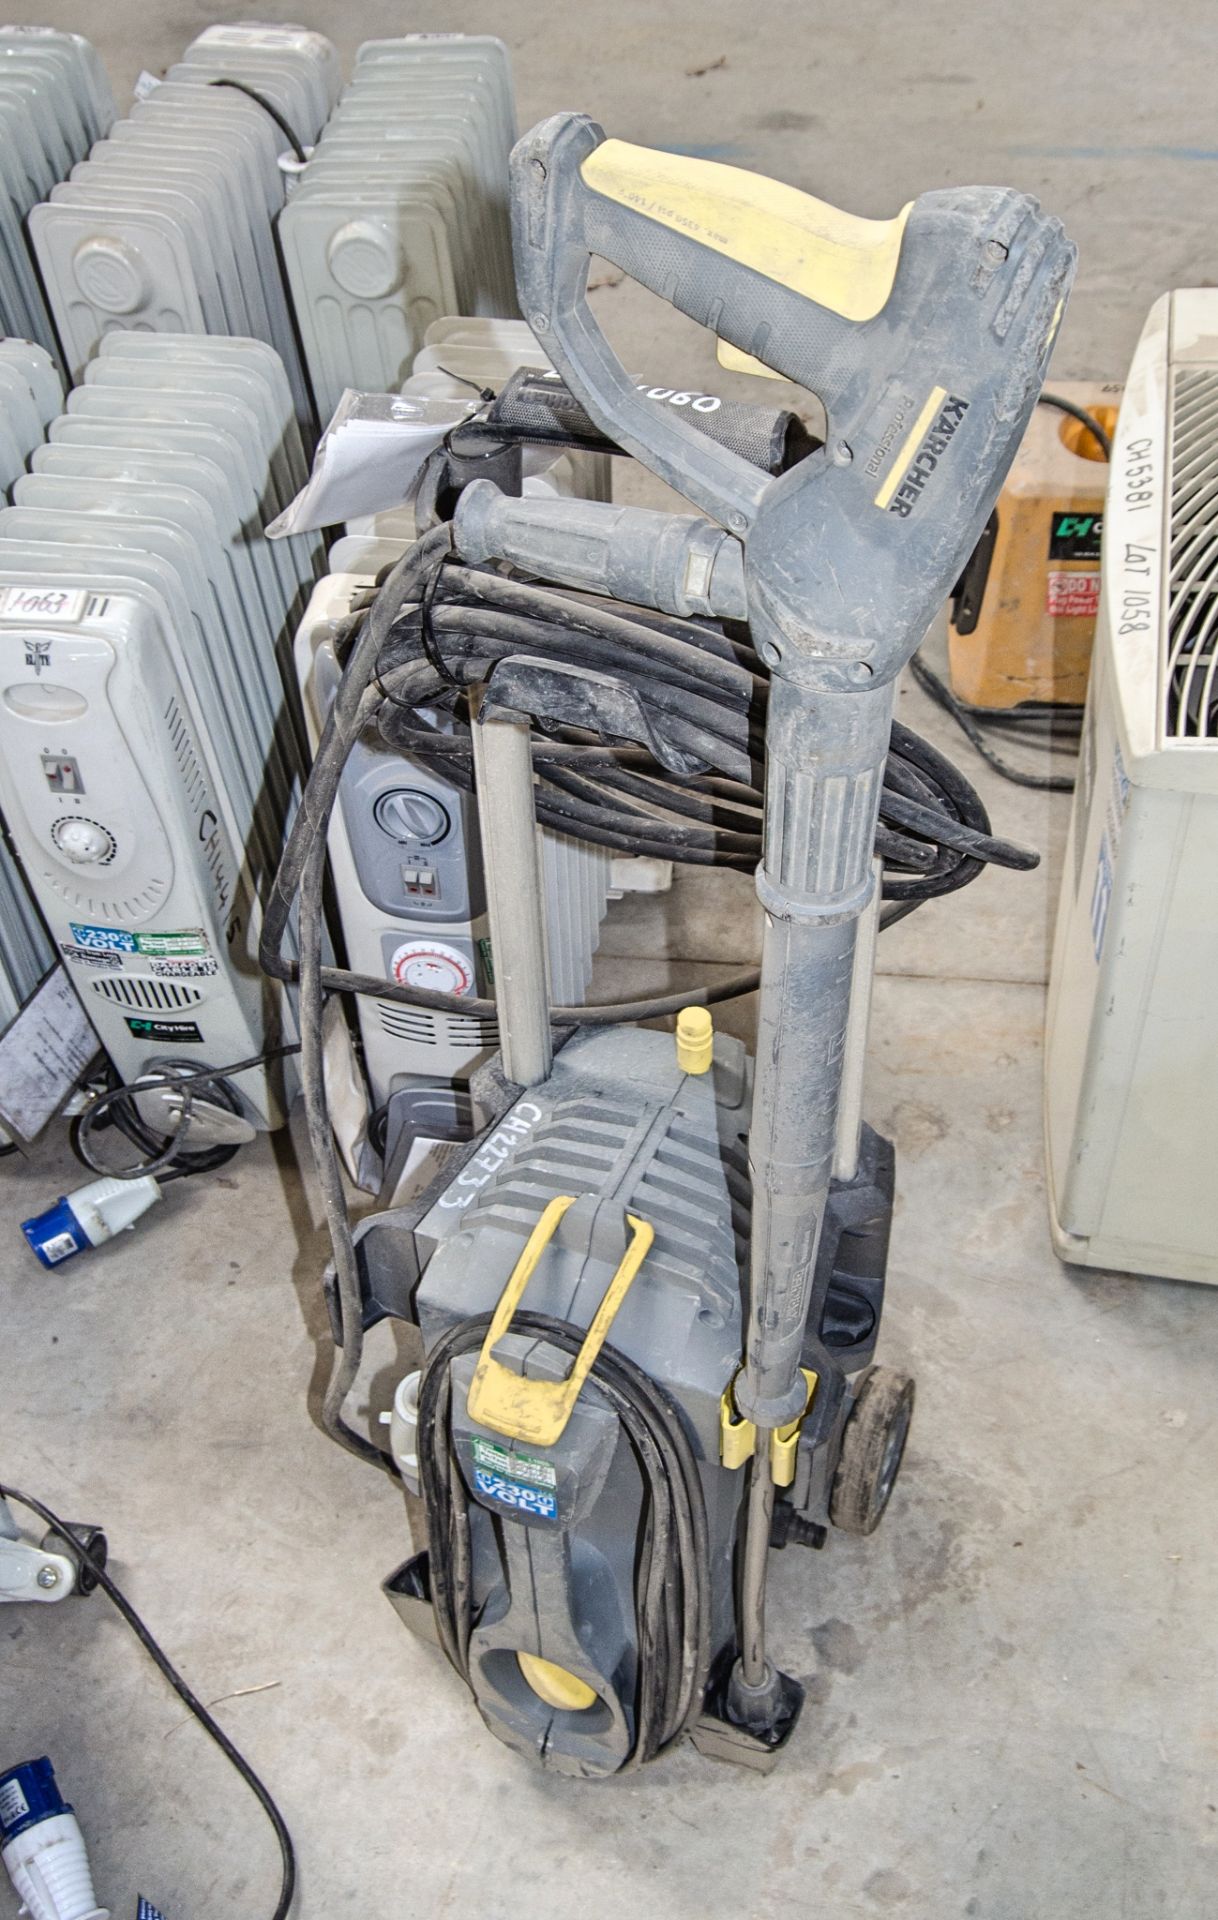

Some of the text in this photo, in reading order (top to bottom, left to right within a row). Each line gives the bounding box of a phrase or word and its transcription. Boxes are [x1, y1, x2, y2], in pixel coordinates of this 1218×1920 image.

[864, 395, 915, 478] Professional
[889, 395, 970, 518] KÄRCHER
[1125, 438, 1154, 512] CH5381
[8, 591, 68, 615] 1063
[1118, 590, 1152, 636] 1058
[77, 936, 135, 952] VOLT
[85, 928, 119, 942] 230
[438, 1102, 542, 1209] CH22733
[477, 1480, 554, 1516] VOLT
[492, 1477, 537, 1502] 230
